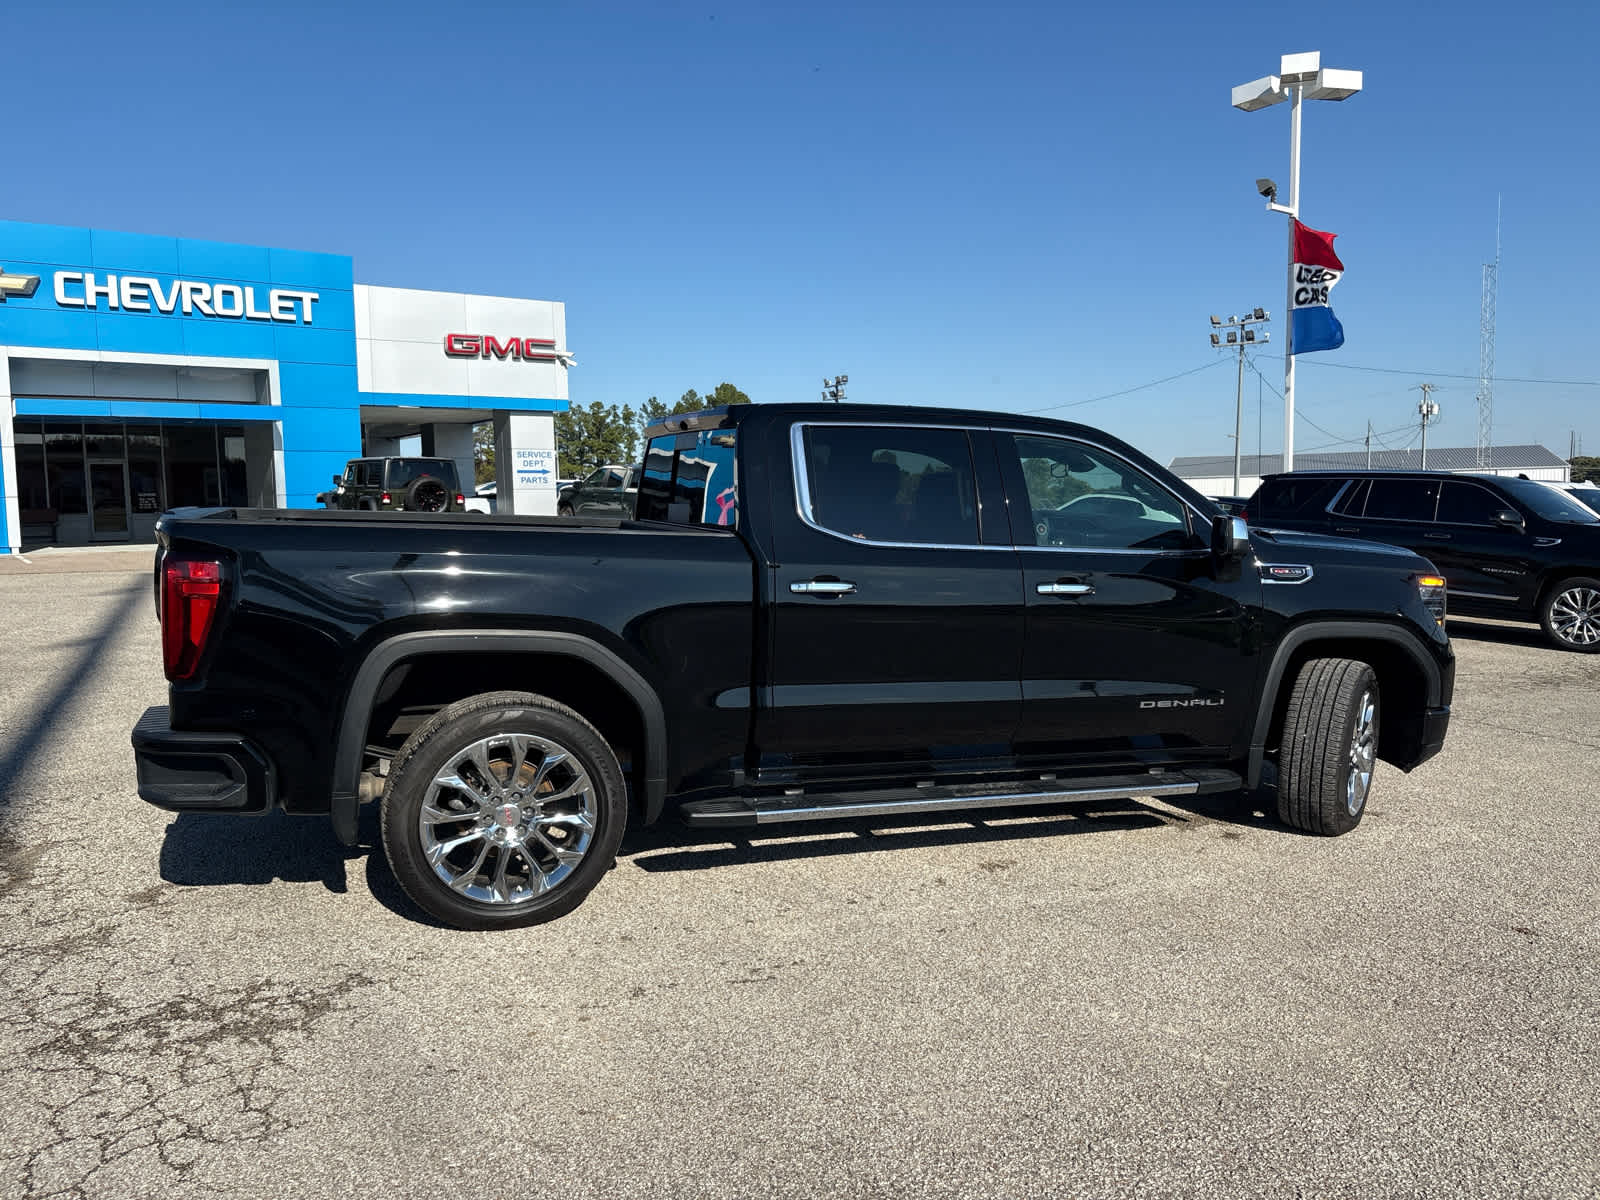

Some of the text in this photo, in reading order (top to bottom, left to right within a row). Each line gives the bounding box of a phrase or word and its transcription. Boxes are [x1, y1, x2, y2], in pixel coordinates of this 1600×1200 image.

[53, 270, 320, 324] CHEVROLET
[444, 333, 556, 363] GMC
[516, 450, 552, 459] SERVICE
[522, 459, 546, 468] DEPT.
[520, 476, 549, 484] PARTS
[1139, 698, 1225, 709] DENALI
